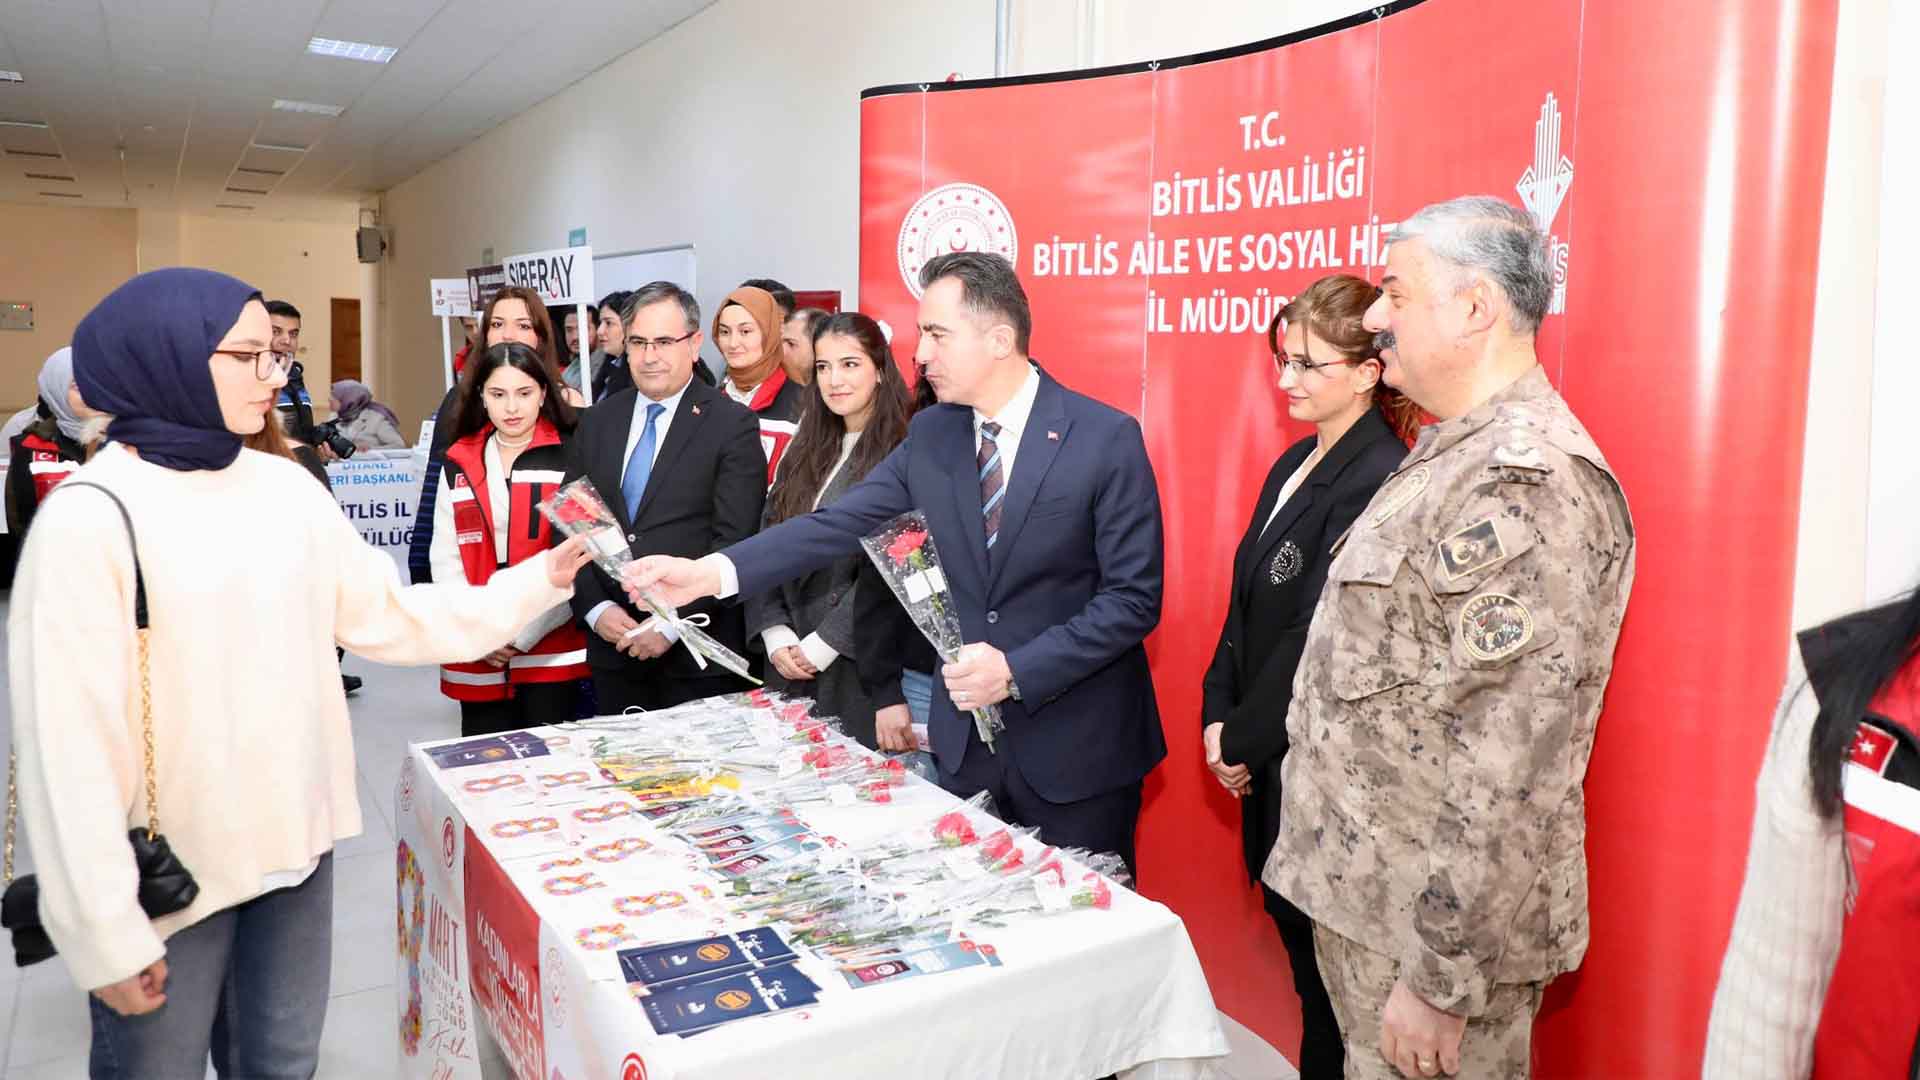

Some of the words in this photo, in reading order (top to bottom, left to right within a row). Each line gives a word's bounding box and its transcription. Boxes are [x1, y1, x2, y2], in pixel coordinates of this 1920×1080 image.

[1239, 112, 1286, 151] T.C.
[1152, 168, 1241, 216] BİTLİS
[1248, 147, 1366, 209] VALİLİĞİ
[1032, 234, 1119, 276] BİTLİS
[1127, 232, 1190, 275] AİLE
[1197, 237, 1233, 273] VE
[1239, 227, 1343, 272] SOSYAL
[1350, 215, 1399, 267] HİZ
[508, 254, 575, 298] SİBERAY
[1148, 289, 1173, 332] İL
[353, 471, 416, 486] BAŞKANL
[340, 499, 388, 519] İTLİS
[395, 498, 412, 518] İL
[476, 911, 541, 1030] KADINLARLA
